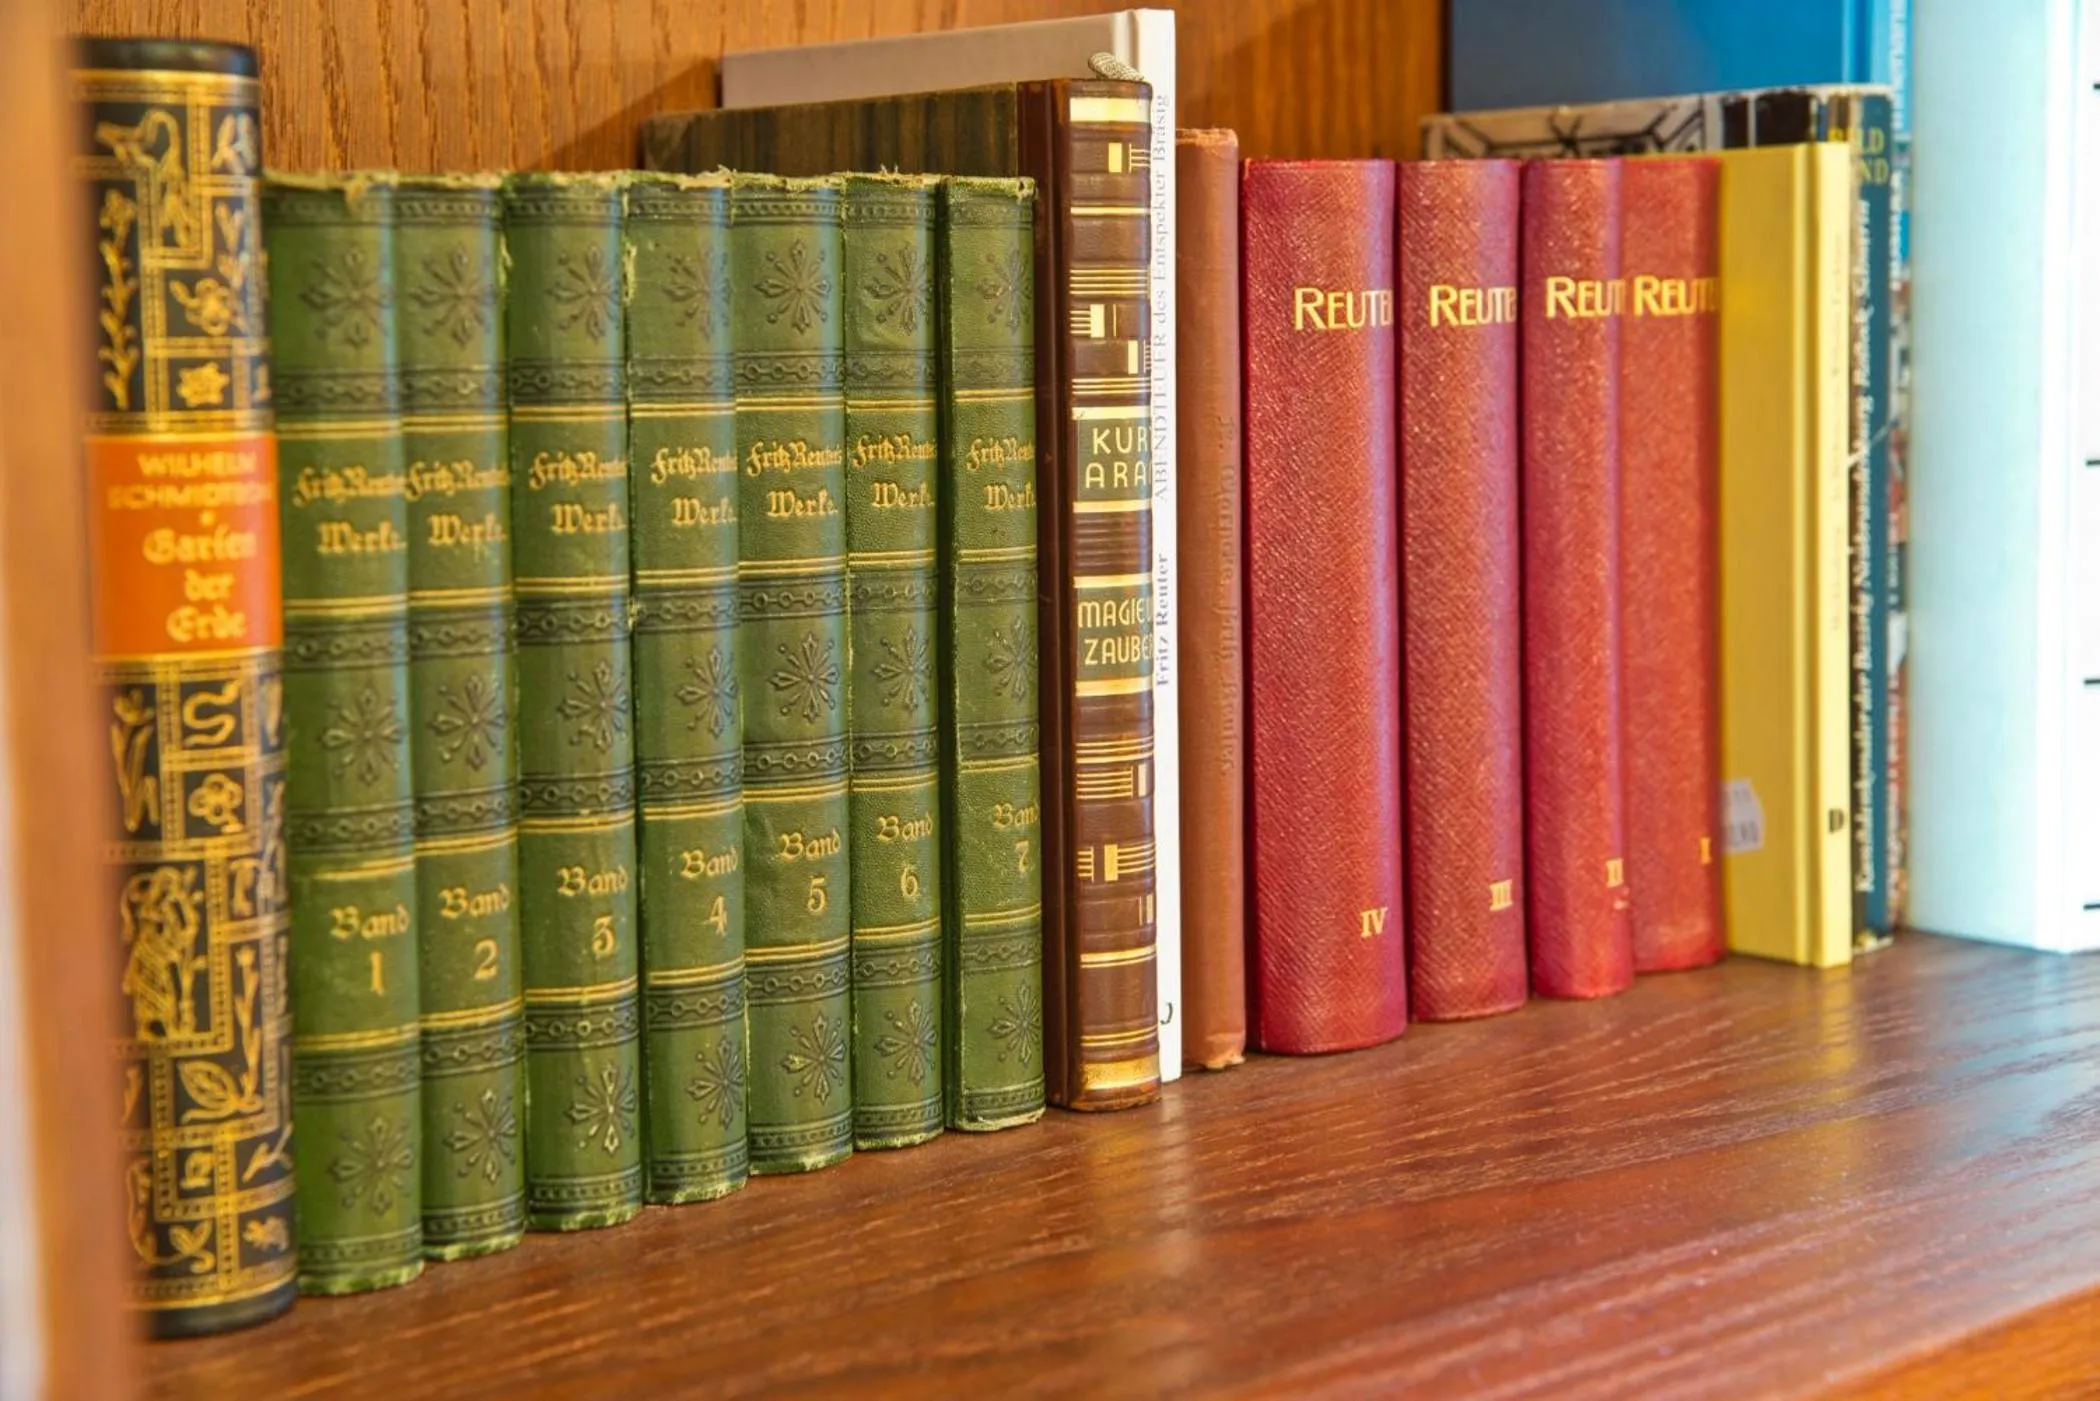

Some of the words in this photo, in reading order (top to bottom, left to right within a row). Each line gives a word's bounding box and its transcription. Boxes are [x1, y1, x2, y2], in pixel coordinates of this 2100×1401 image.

[1546, 276, 1625, 318] REUT
[1634, 275, 1718, 317] REUT
[1092, 426, 1153, 455] KUR
[1085, 460, 1153, 490] ARA
[1155, 553, 1169, 627] Reuter
[779, 827, 842, 863] Band
[876, 814, 934, 844] Band
[680, 847, 738, 881] Band
[1015, 840, 1032, 875] 7
[556, 865, 629, 898] Band
[806, 874, 829, 917] 5
[900, 863, 919, 902] 6
[438, 882, 511, 920] Band
[704, 894, 729, 937] 4
[329, 903, 410, 940] Band
[592, 910, 617, 959] 3
[1359, 906, 1389, 938] IV
[369, 949, 386, 997] 1
[473, 938, 499, 981] 2
